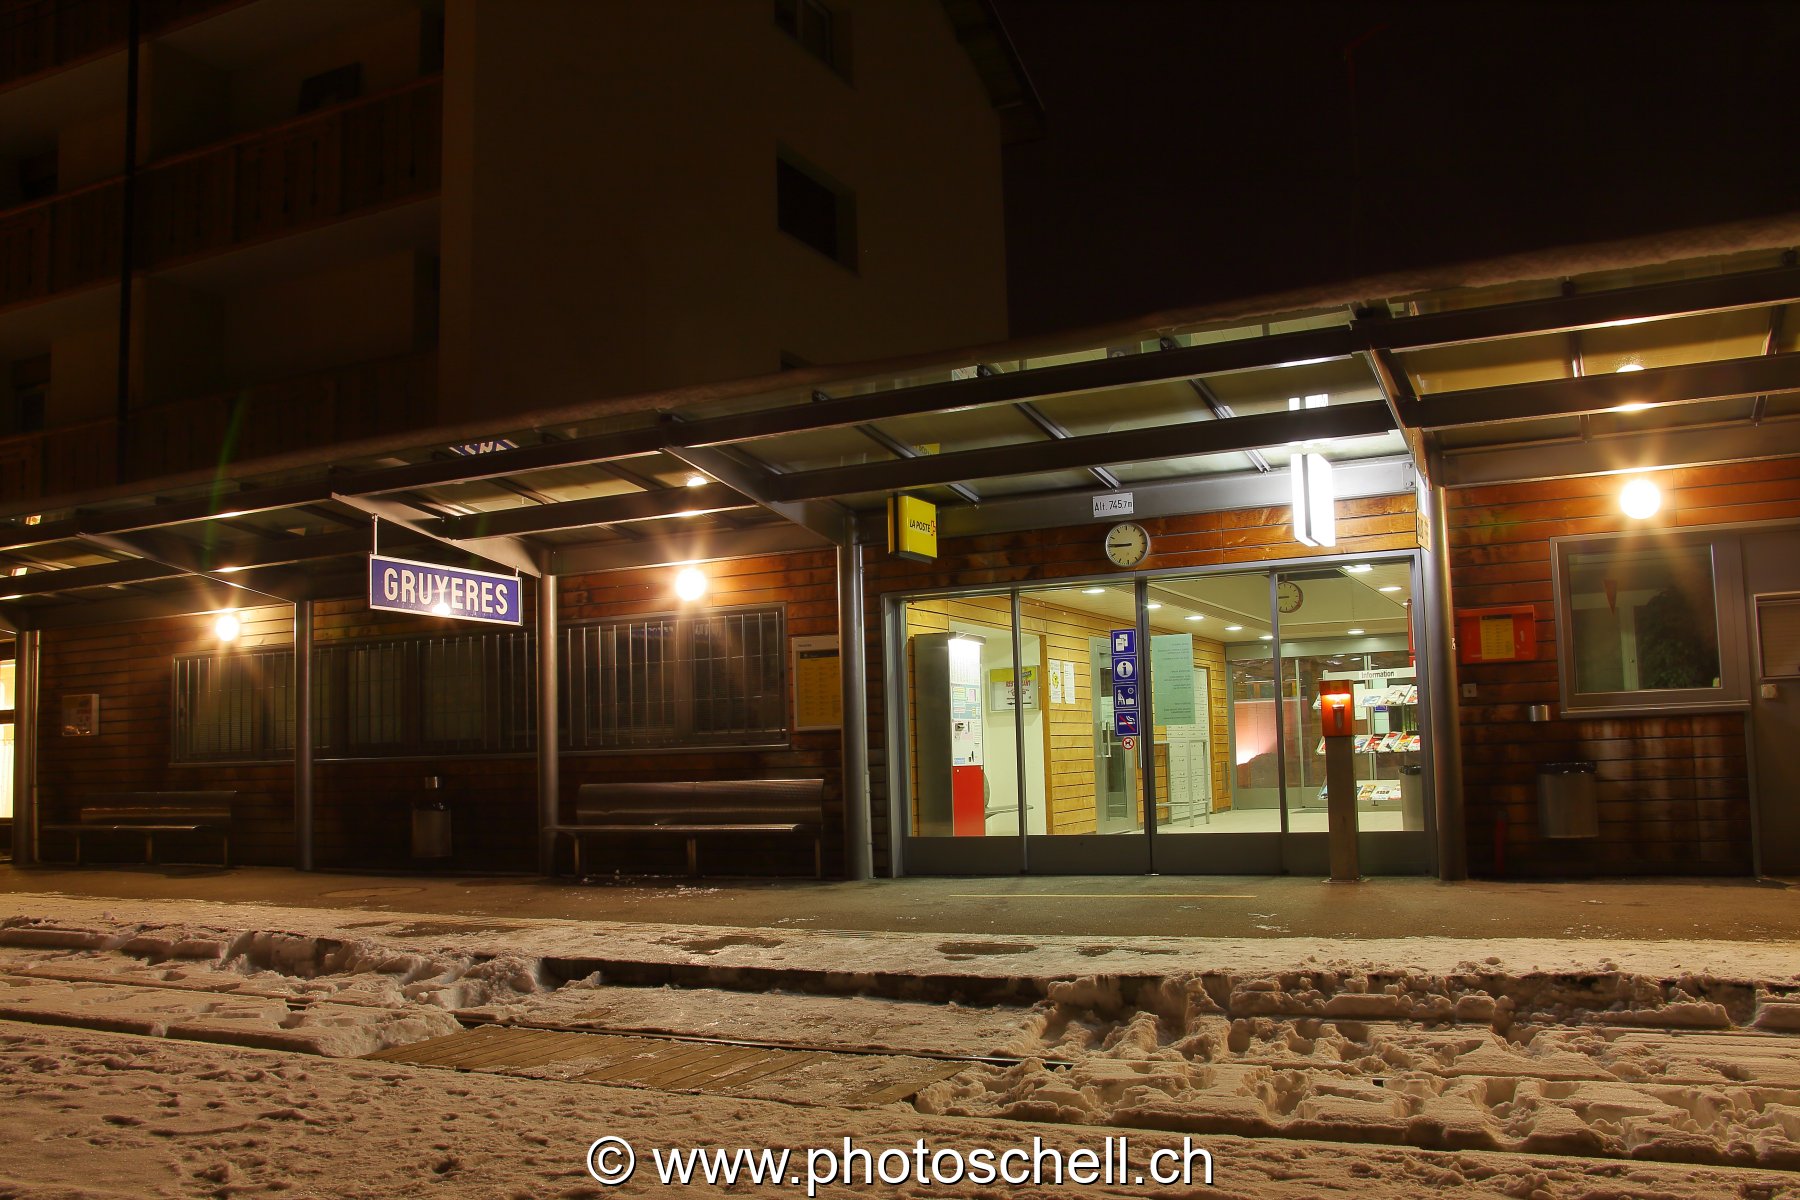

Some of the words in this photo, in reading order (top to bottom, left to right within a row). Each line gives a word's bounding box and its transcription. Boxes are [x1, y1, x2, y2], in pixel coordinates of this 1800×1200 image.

[1094, 501, 1108, 512] Alt.
[909, 518, 916, 528] LA
[916, 520, 931, 533] POSTE
[384, 568, 508, 615] GRUYERES
[1361, 670, 1395, 679] Information
